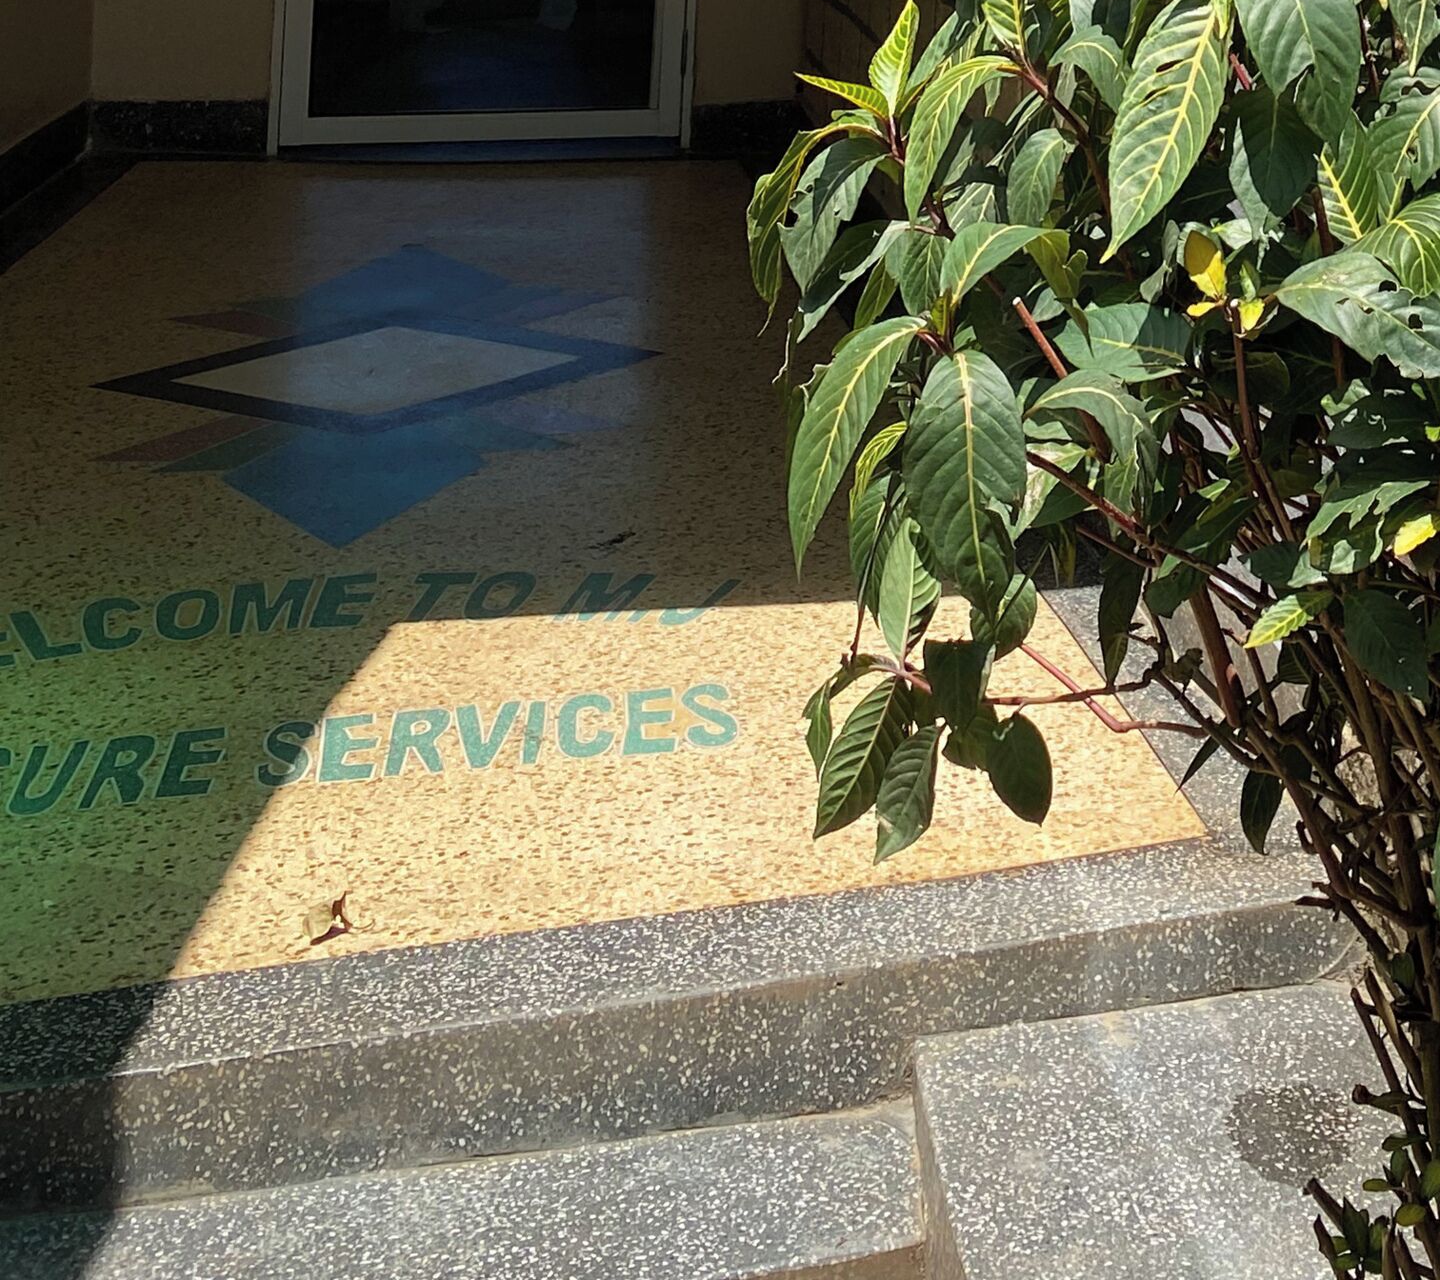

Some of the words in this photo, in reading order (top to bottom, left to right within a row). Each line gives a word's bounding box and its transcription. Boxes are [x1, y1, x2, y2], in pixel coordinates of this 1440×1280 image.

[0, 572, 378, 667] LCOME
[405, 571, 537, 621] TO
[0, 726, 228, 816] URE
[256, 683, 738, 787] SERVICES
